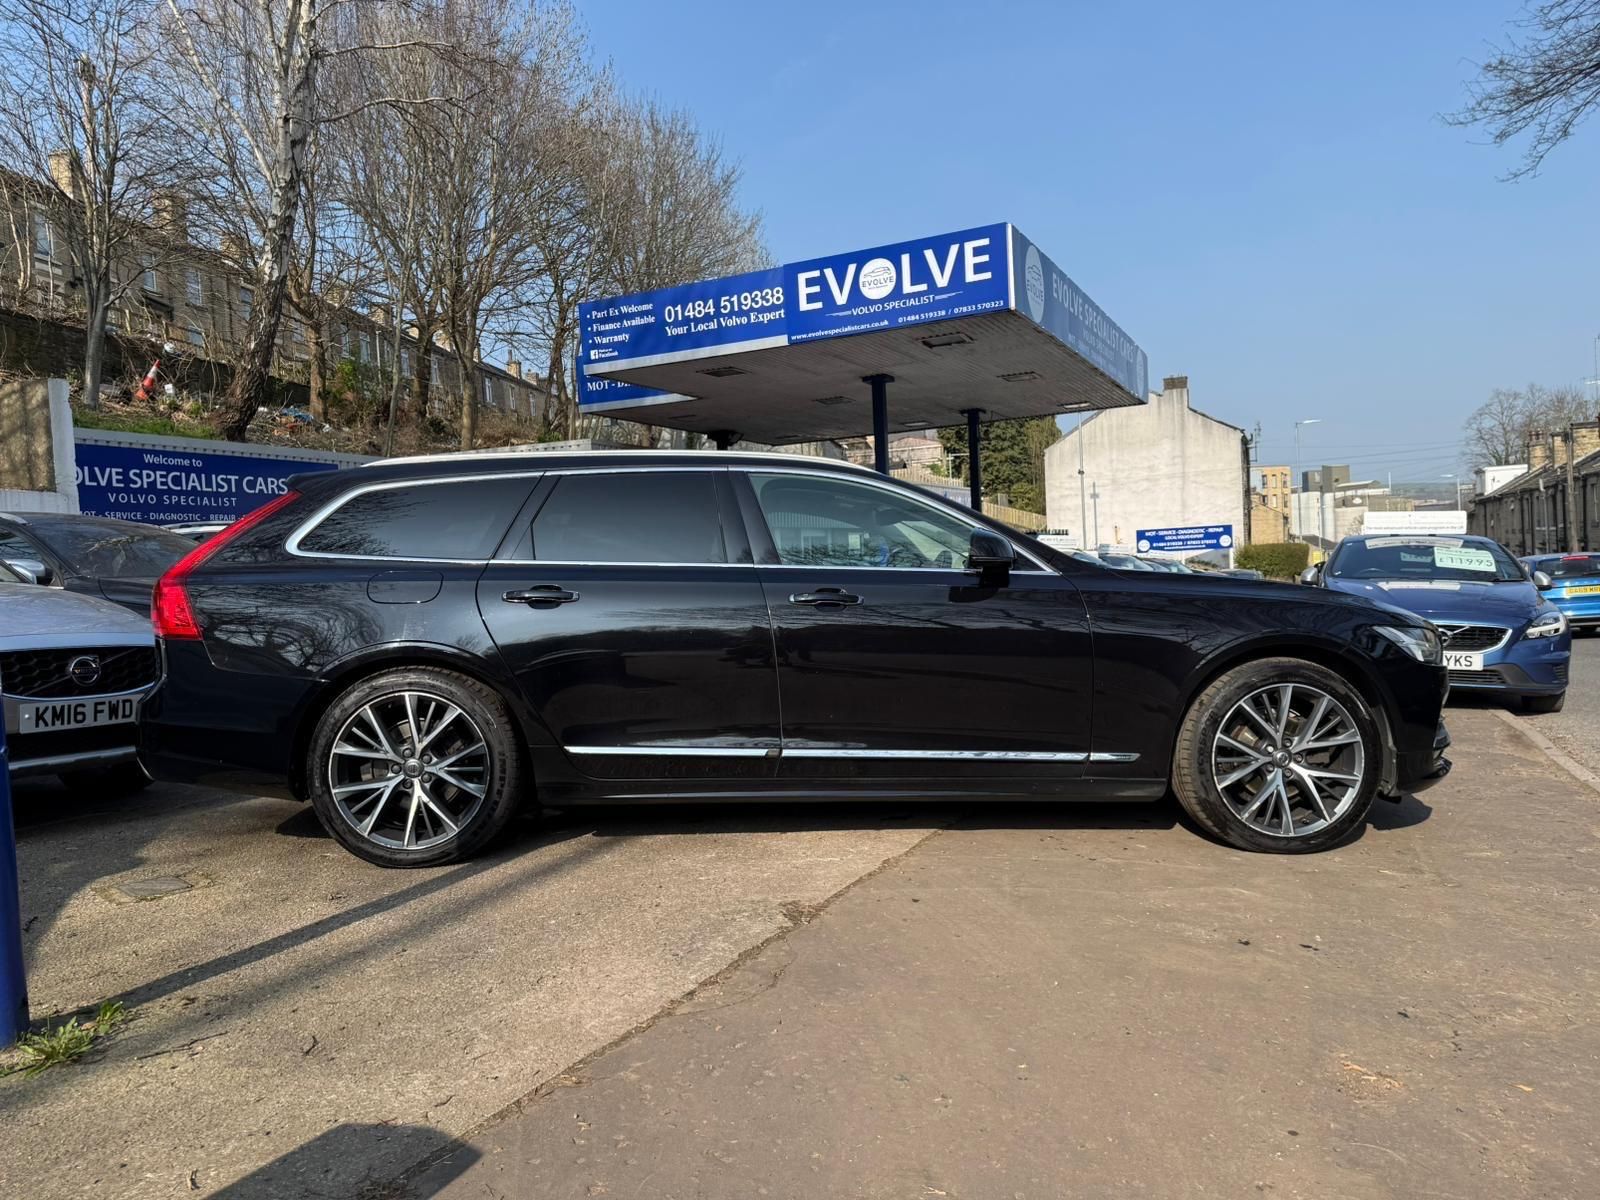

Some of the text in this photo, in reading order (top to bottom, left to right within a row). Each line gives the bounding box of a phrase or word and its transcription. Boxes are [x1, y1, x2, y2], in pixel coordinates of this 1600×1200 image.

[797, 237, 992, 312] EVOLVE
[862, 275, 894, 288] EVOLVE
[592, 303, 654, 319] Part Ex Welcome
[664, 286, 784, 323] 01484 519338
[852, 294, 935, 316] VOLVO SPECIALIST
[898, 312, 920, 323] 01484
[920, 309, 946, 320] 519338
[954, 304, 977, 314] 07833
[977, 299, 1004, 311] 570323
[1052, 272, 1083, 321] EVOLVE
[1084, 303, 1120, 349] SPECIALIST
[593, 315, 656, 332] Finance Available
[665, 308, 785, 337] Your Local Volvo Expert
[790, 319, 889, 341] www.evolvespecialistcars.co.uk
[594, 333, 630, 345] Warranty
[587, 380, 609, 391] MOT
[143, 453, 202, 468] Welcome to
[129, 468, 238, 493] SPECIALIST
[242, 476, 289, 495] CARS
[108, 492, 237, 507] VOLVO SPECIALIST
[105, 511, 142, 520] SERVICE
[149, 512, 201, 521] DIAGNOSTIC
[209, 513, 236, 521] REPAIR
[1443, 655, 1473, 668] YKS
[35, 698, 133, 728] KM16 FWD
